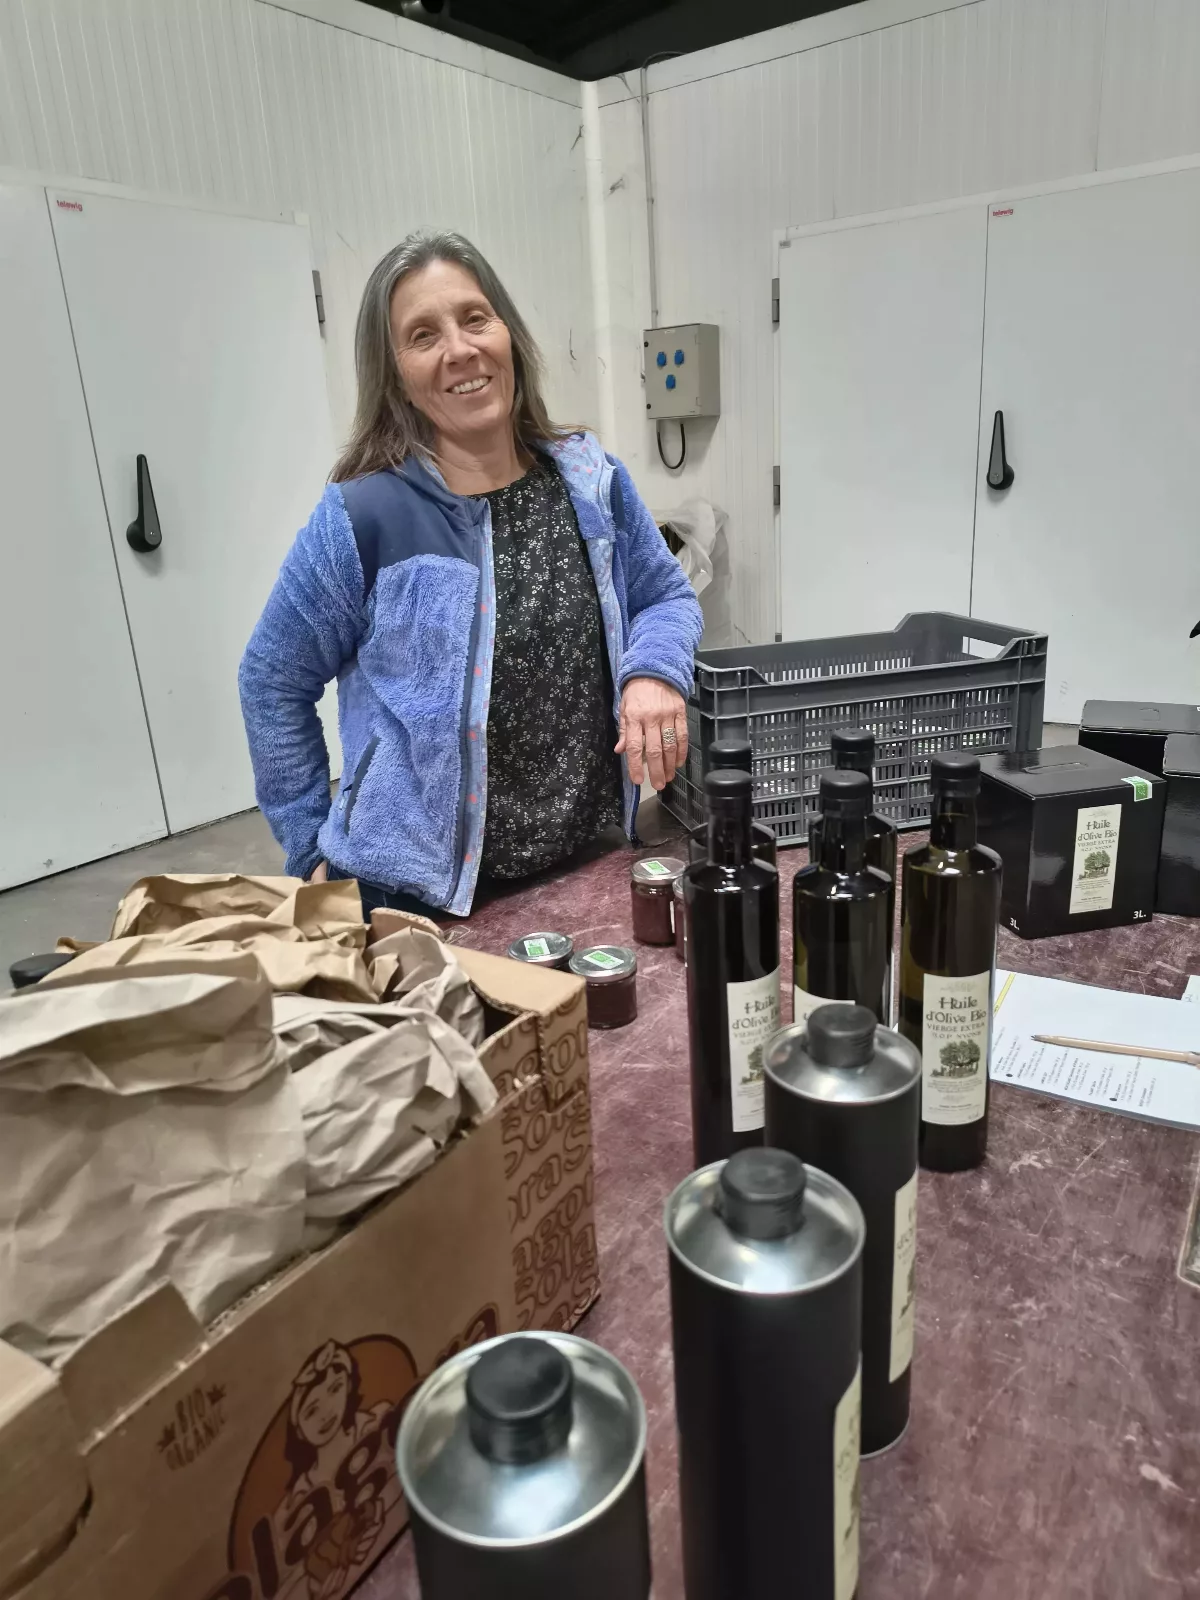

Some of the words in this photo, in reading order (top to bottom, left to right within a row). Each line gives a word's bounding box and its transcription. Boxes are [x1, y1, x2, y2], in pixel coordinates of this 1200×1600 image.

[1086, 819, 1111, 831] Huile
[1077, 831, 1103, 842] d'Olive
[1104, 829, 1118, 838] Bio
[1132, 909, 1147, 919] 3L.
[1009, 916, 1020, 931] 3L.
[743, 994, 776, 1015] Huile
[938, 995, 979, 1010] Huile
[731, 1015, 769, 1030] d'Olive
[925, 1010, 968, 1024] d'Olive
[969, 1009, 987, 1022] Bio
